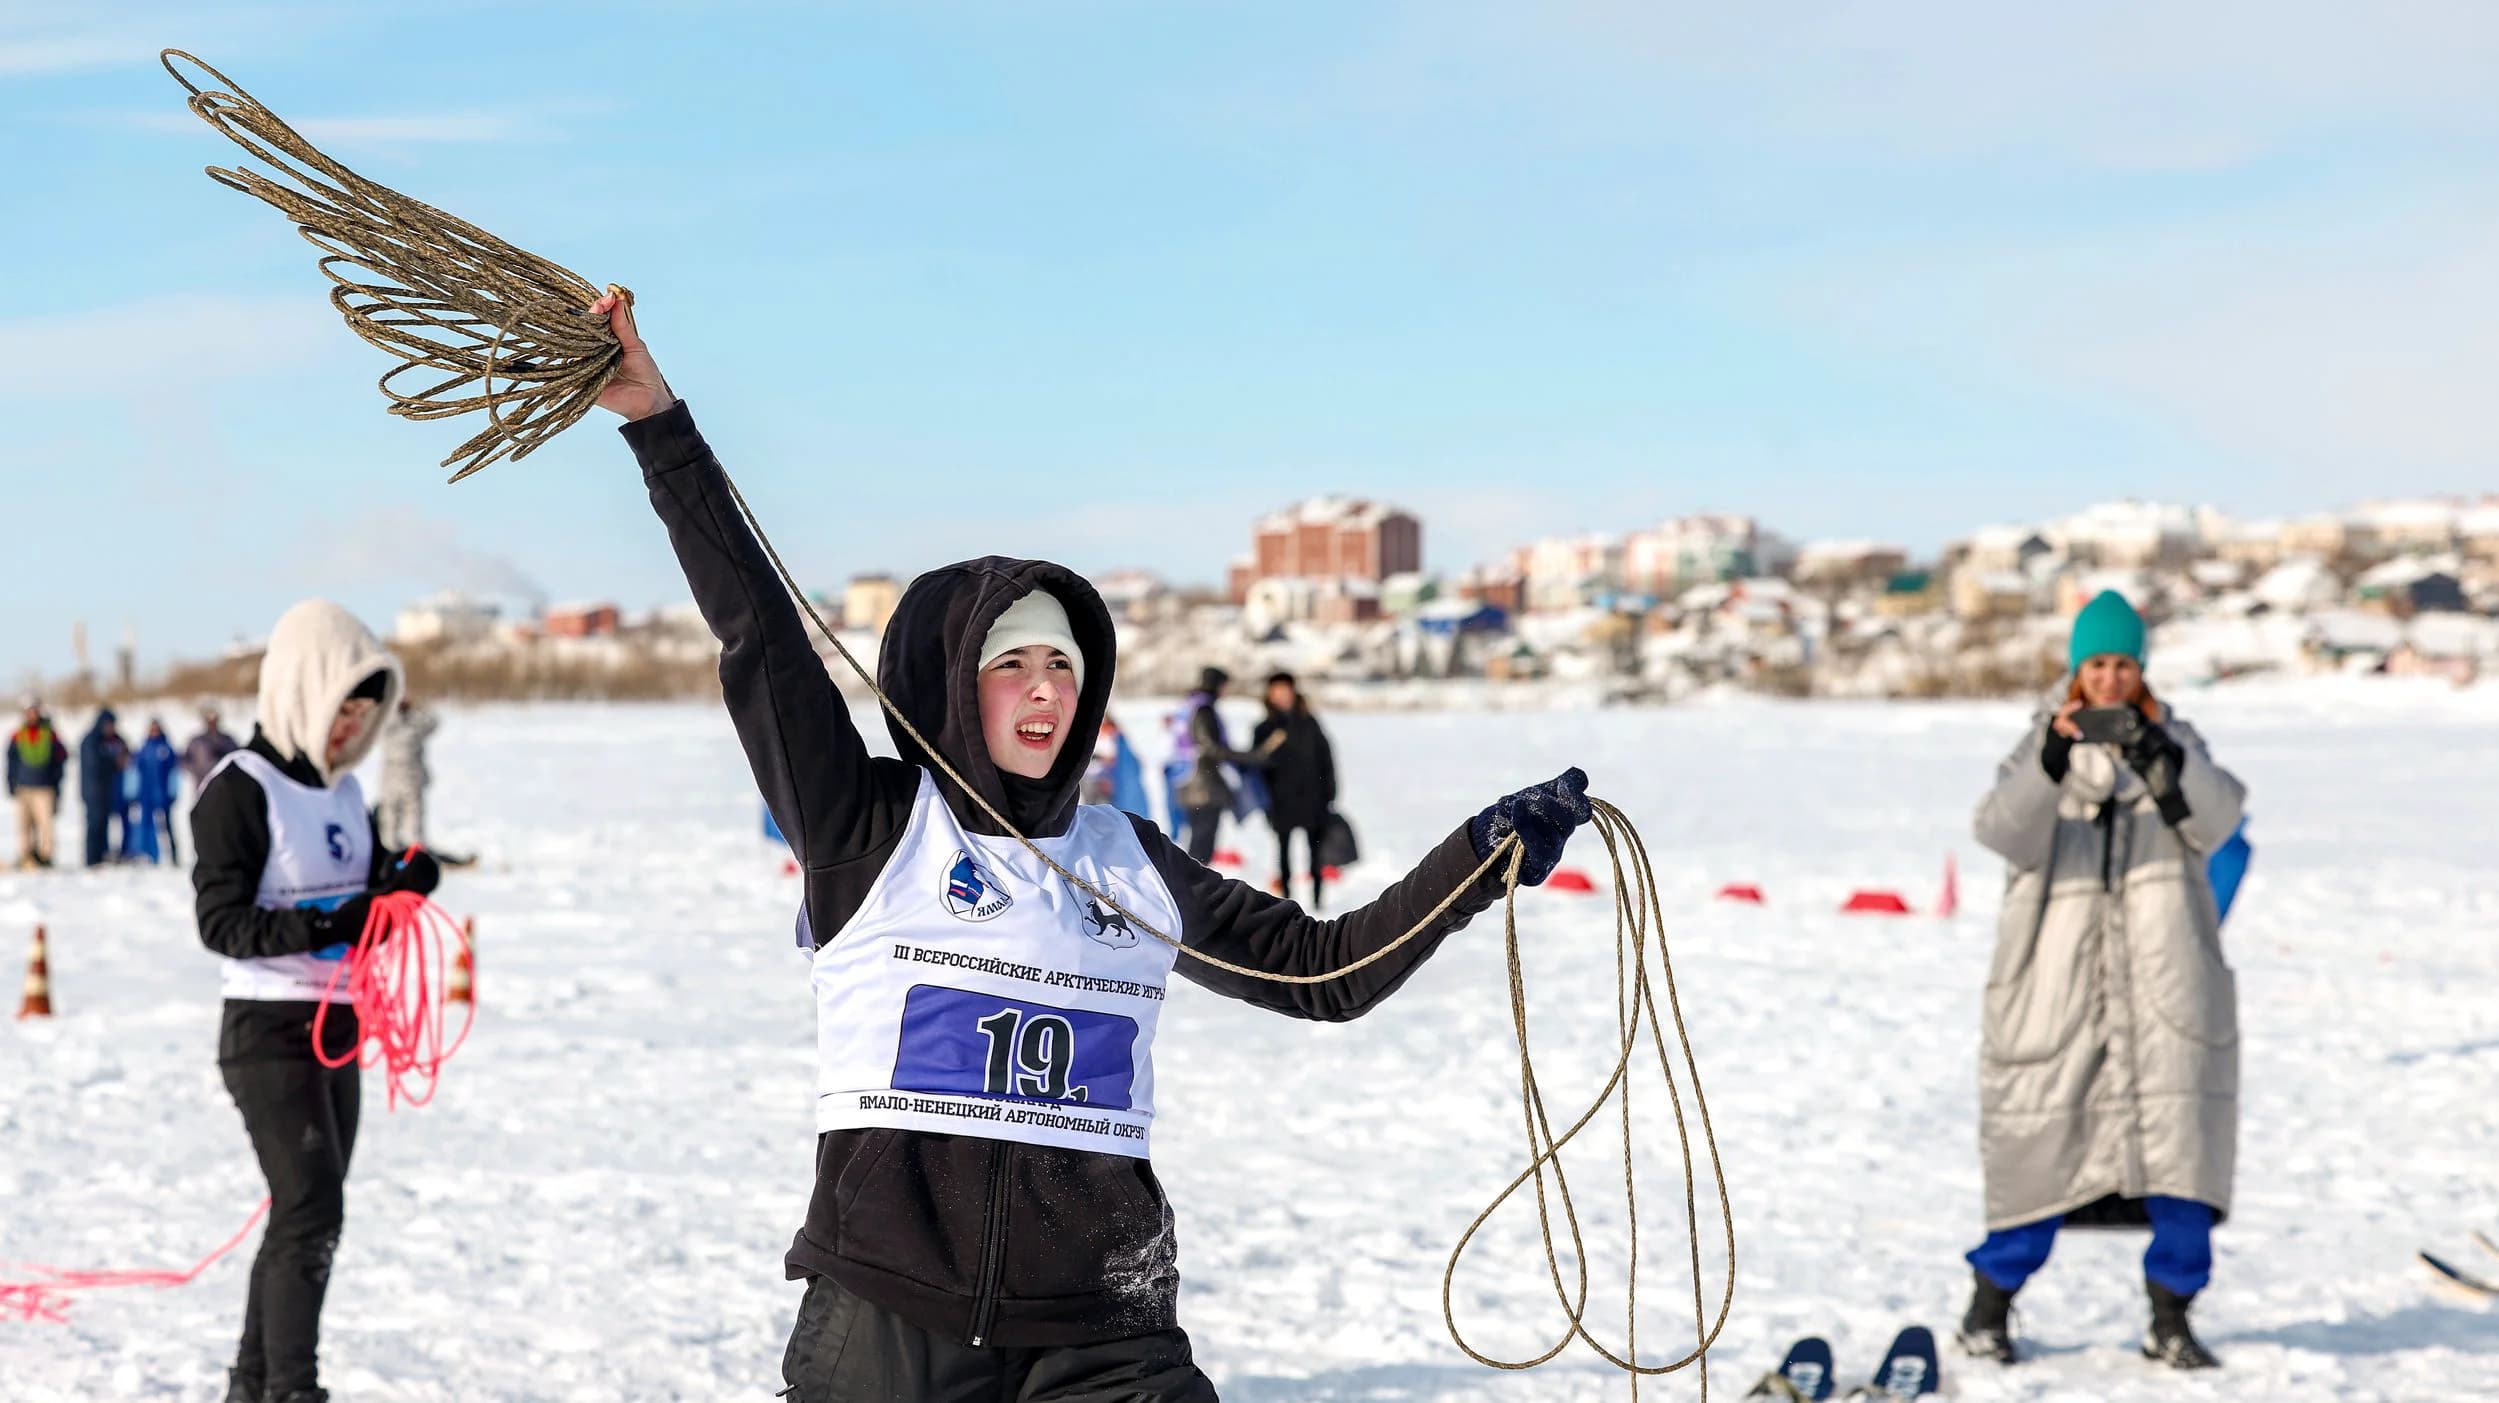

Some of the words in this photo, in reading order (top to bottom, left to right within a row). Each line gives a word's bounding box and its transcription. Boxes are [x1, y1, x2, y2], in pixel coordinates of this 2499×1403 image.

[893, 944, 911, 960] III
[912, 947, 1042, 983] ВСЕРОССИЙСКИЕ
[1043, 970, 1141, 997] АРКТИЧЕСКИЕ
[859, 1095, 1002, 1121] ЯМАЛО-НЕНЕЦКИЙ
[1004, 1109, 1111, 1136] АВТОНОМНЫЙ
[1112, 1122, 1146, 1140] ОКРУГ
